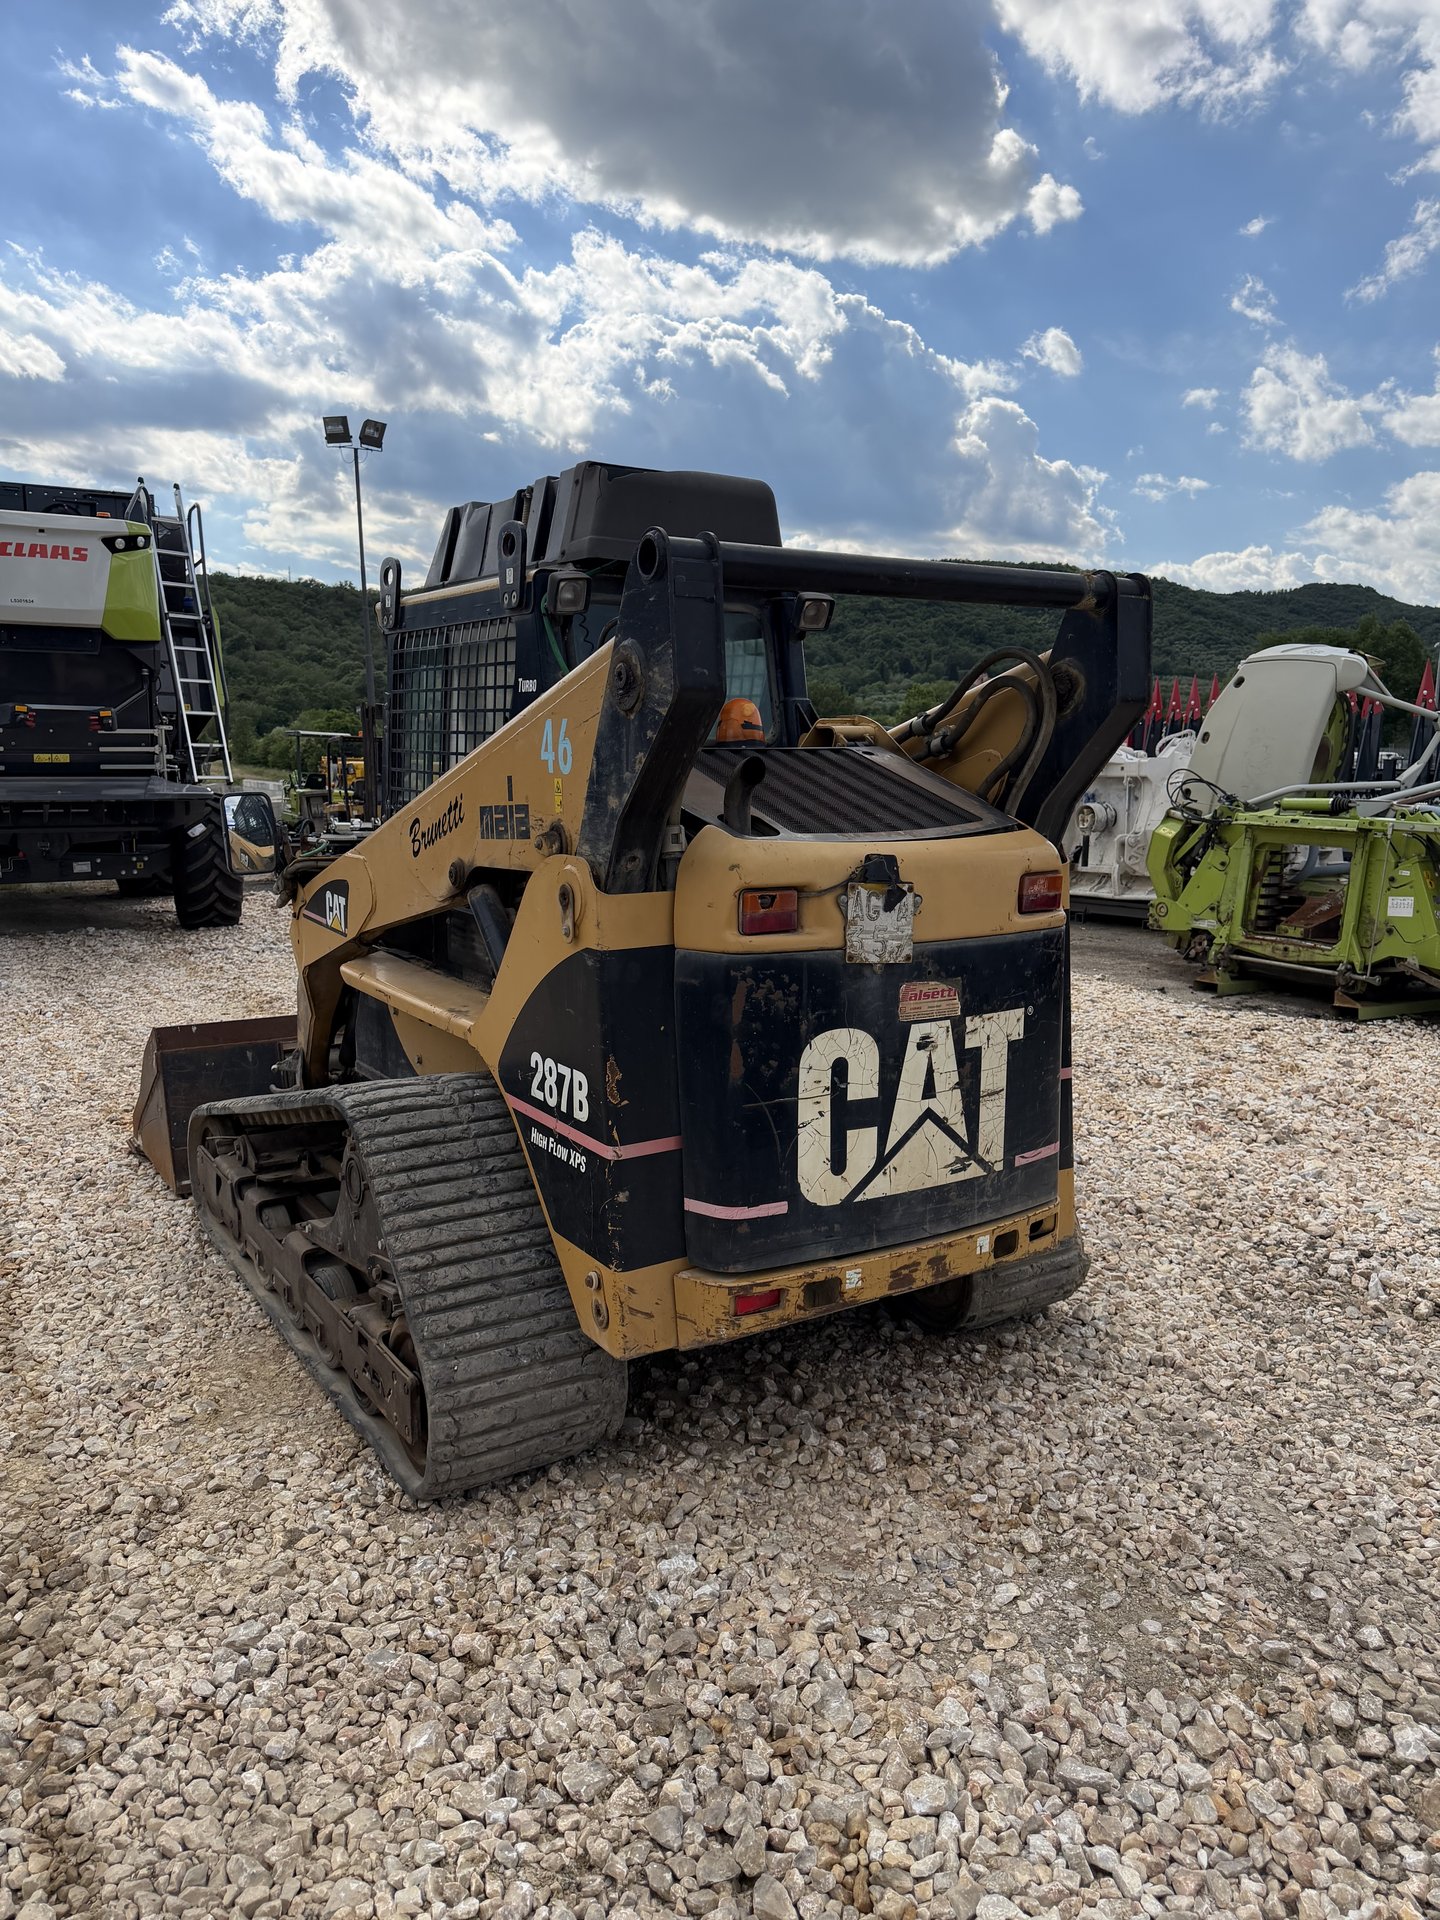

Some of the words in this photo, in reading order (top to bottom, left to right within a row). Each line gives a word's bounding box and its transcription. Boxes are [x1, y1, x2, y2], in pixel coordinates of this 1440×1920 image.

[0, 541, 88, 562] CLAAS
[540, 718, 573, 775] 46
[409, 792, 466, 858] Brunetti
[325, 890, 346, 934] CAT
[530, 1051, 589, 1123] 287B
[797, 1008, 1025, 1207] CAT
[568, 1148, 587, 1174] XPS
